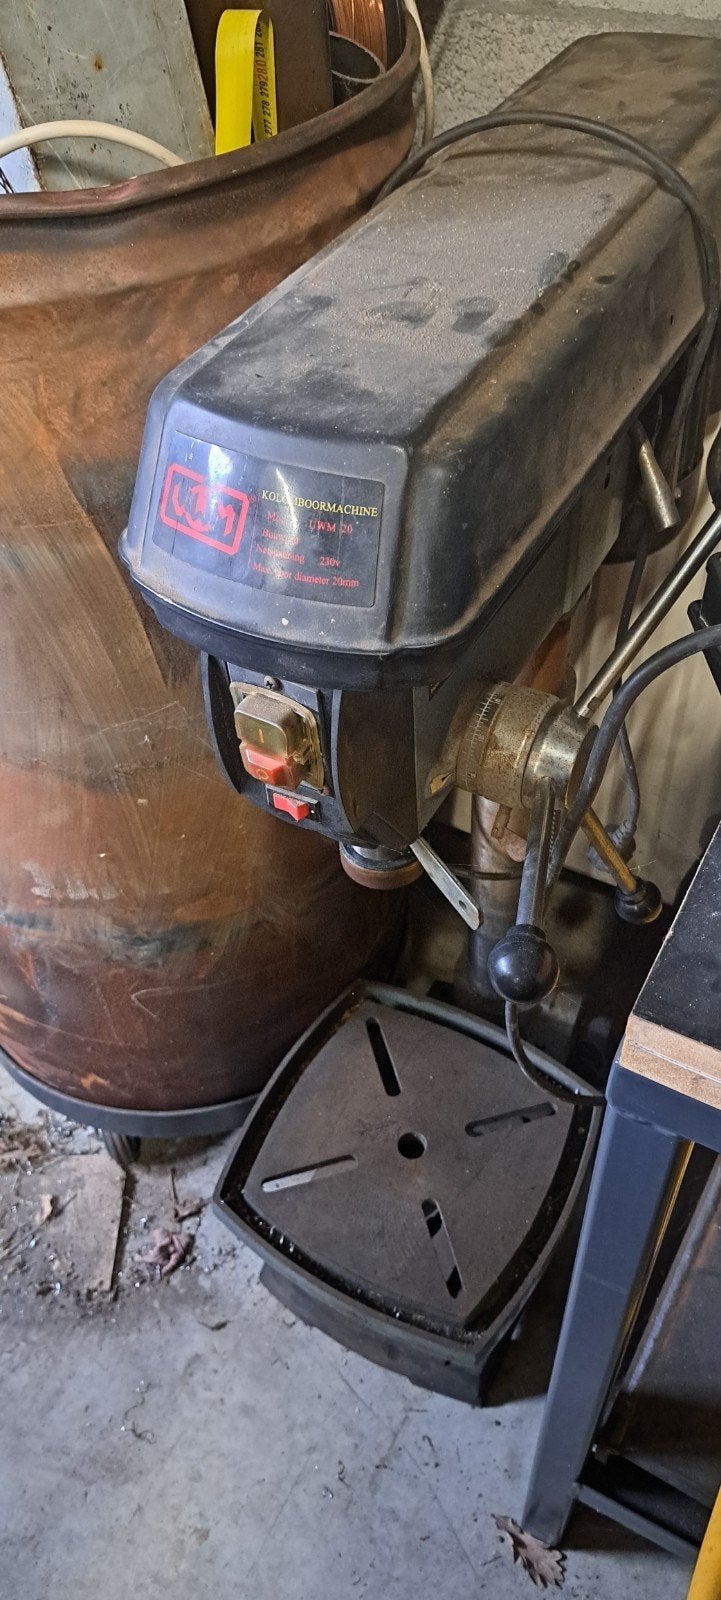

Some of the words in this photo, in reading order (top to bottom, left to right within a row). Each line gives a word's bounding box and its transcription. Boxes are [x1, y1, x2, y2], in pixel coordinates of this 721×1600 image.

[255, 42, 265, 59] 281
[257, 61, 269, 82] 280
[259, 82, 270, 98] 279
[261, 101, 272, 117] 278
[265, 120, 273, 136] 277
[262, 490, 378, 517] KOLOBOORMACHINE
[309, 519, 336, 533] UWM
[341, 523, 353, 534] 20
[319, 556, 341, 568] 230v
[294, 571, 329, 585] diameter
[332, 576, 360, 588] 20mm
